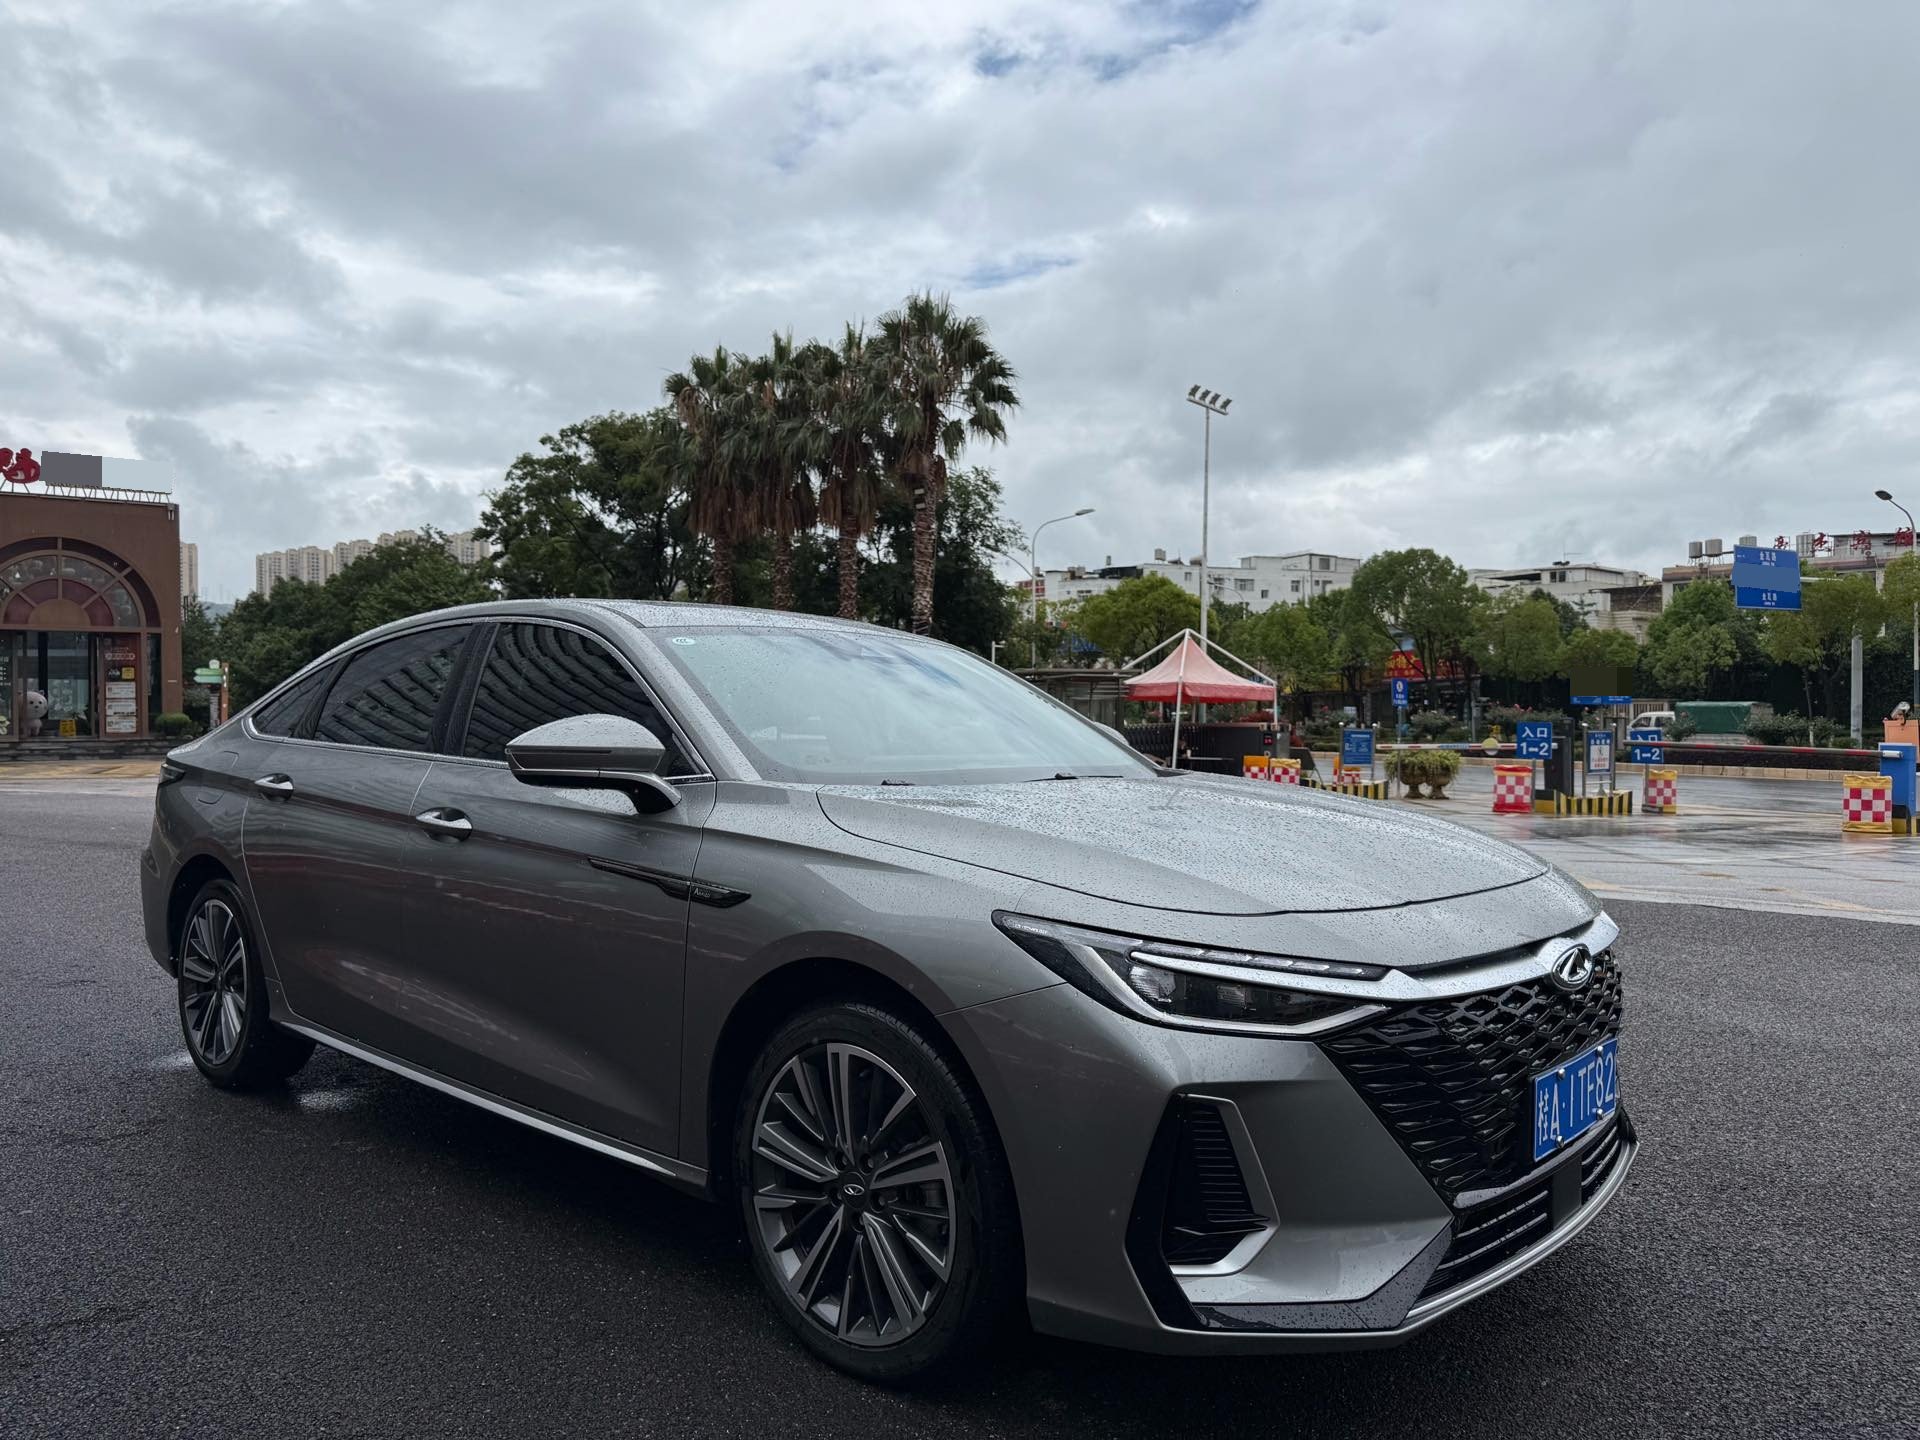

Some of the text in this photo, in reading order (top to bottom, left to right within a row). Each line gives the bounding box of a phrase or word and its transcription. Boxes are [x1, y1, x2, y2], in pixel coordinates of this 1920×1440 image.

[1521, 726, 1548, 739] 入口
[1520, 741, 1549, 756] 1-2
[1634, 747, 1661, 761] 1-2
